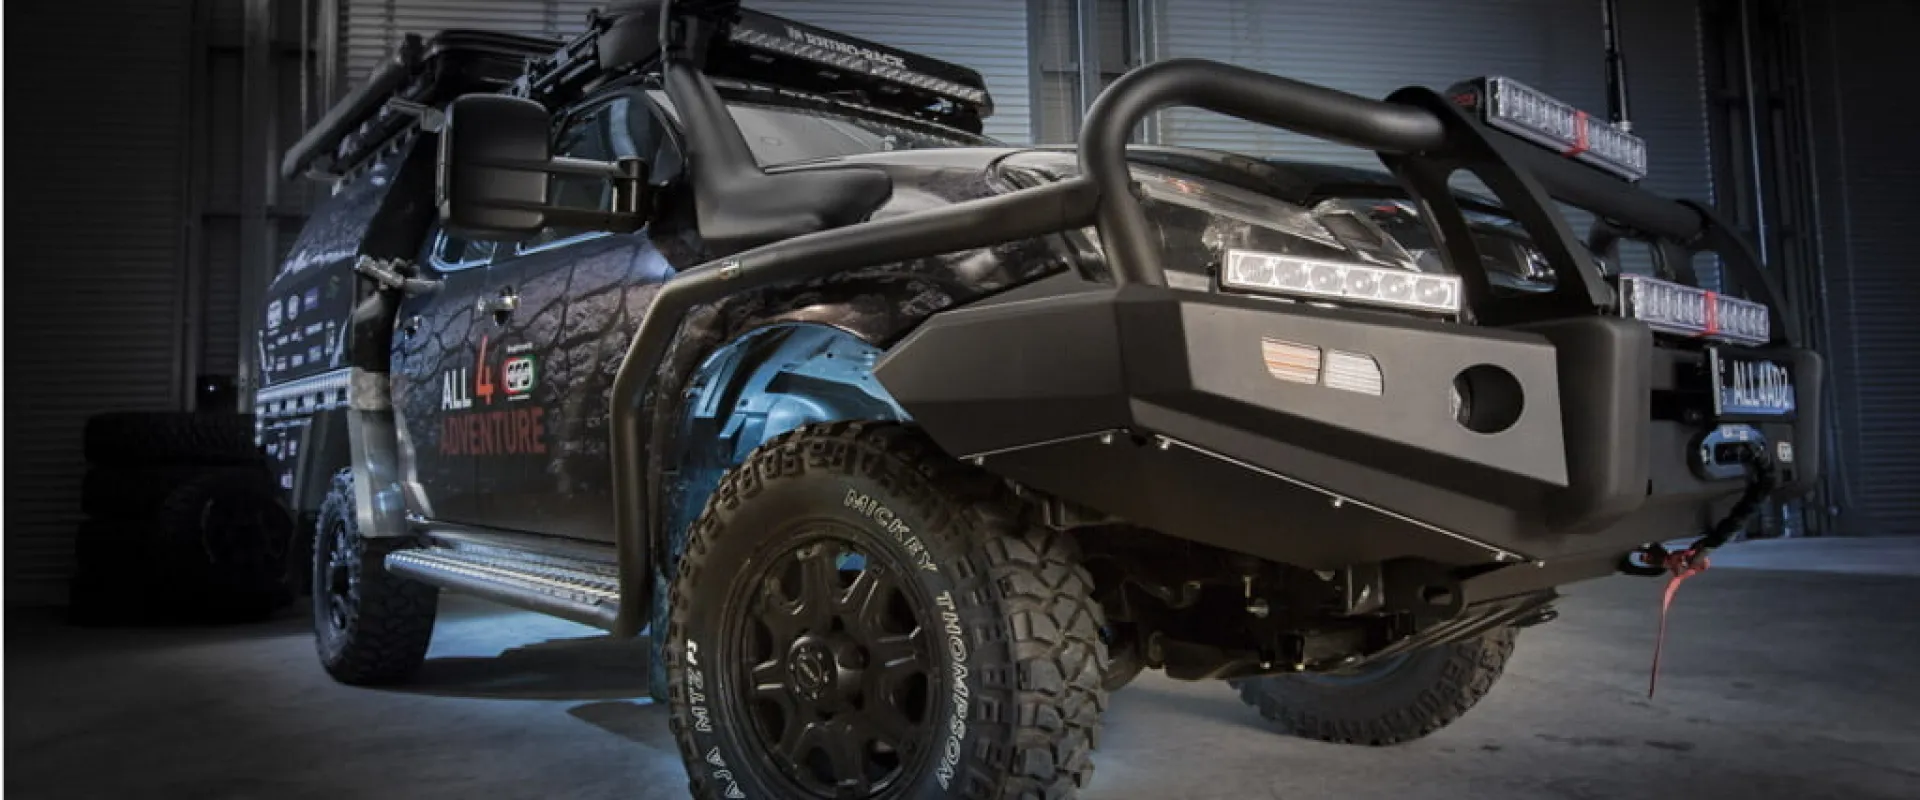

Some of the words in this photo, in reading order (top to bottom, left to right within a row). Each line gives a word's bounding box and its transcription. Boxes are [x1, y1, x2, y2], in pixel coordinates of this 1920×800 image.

[442, 367, 472, 411] ALL
[475, 335, 494, 405] 4
[442, 408, 545, 454] ADVENTURE
[844, 488, 939, 573] MICKEY
[934, 589, 970, 792] THOMPSON
